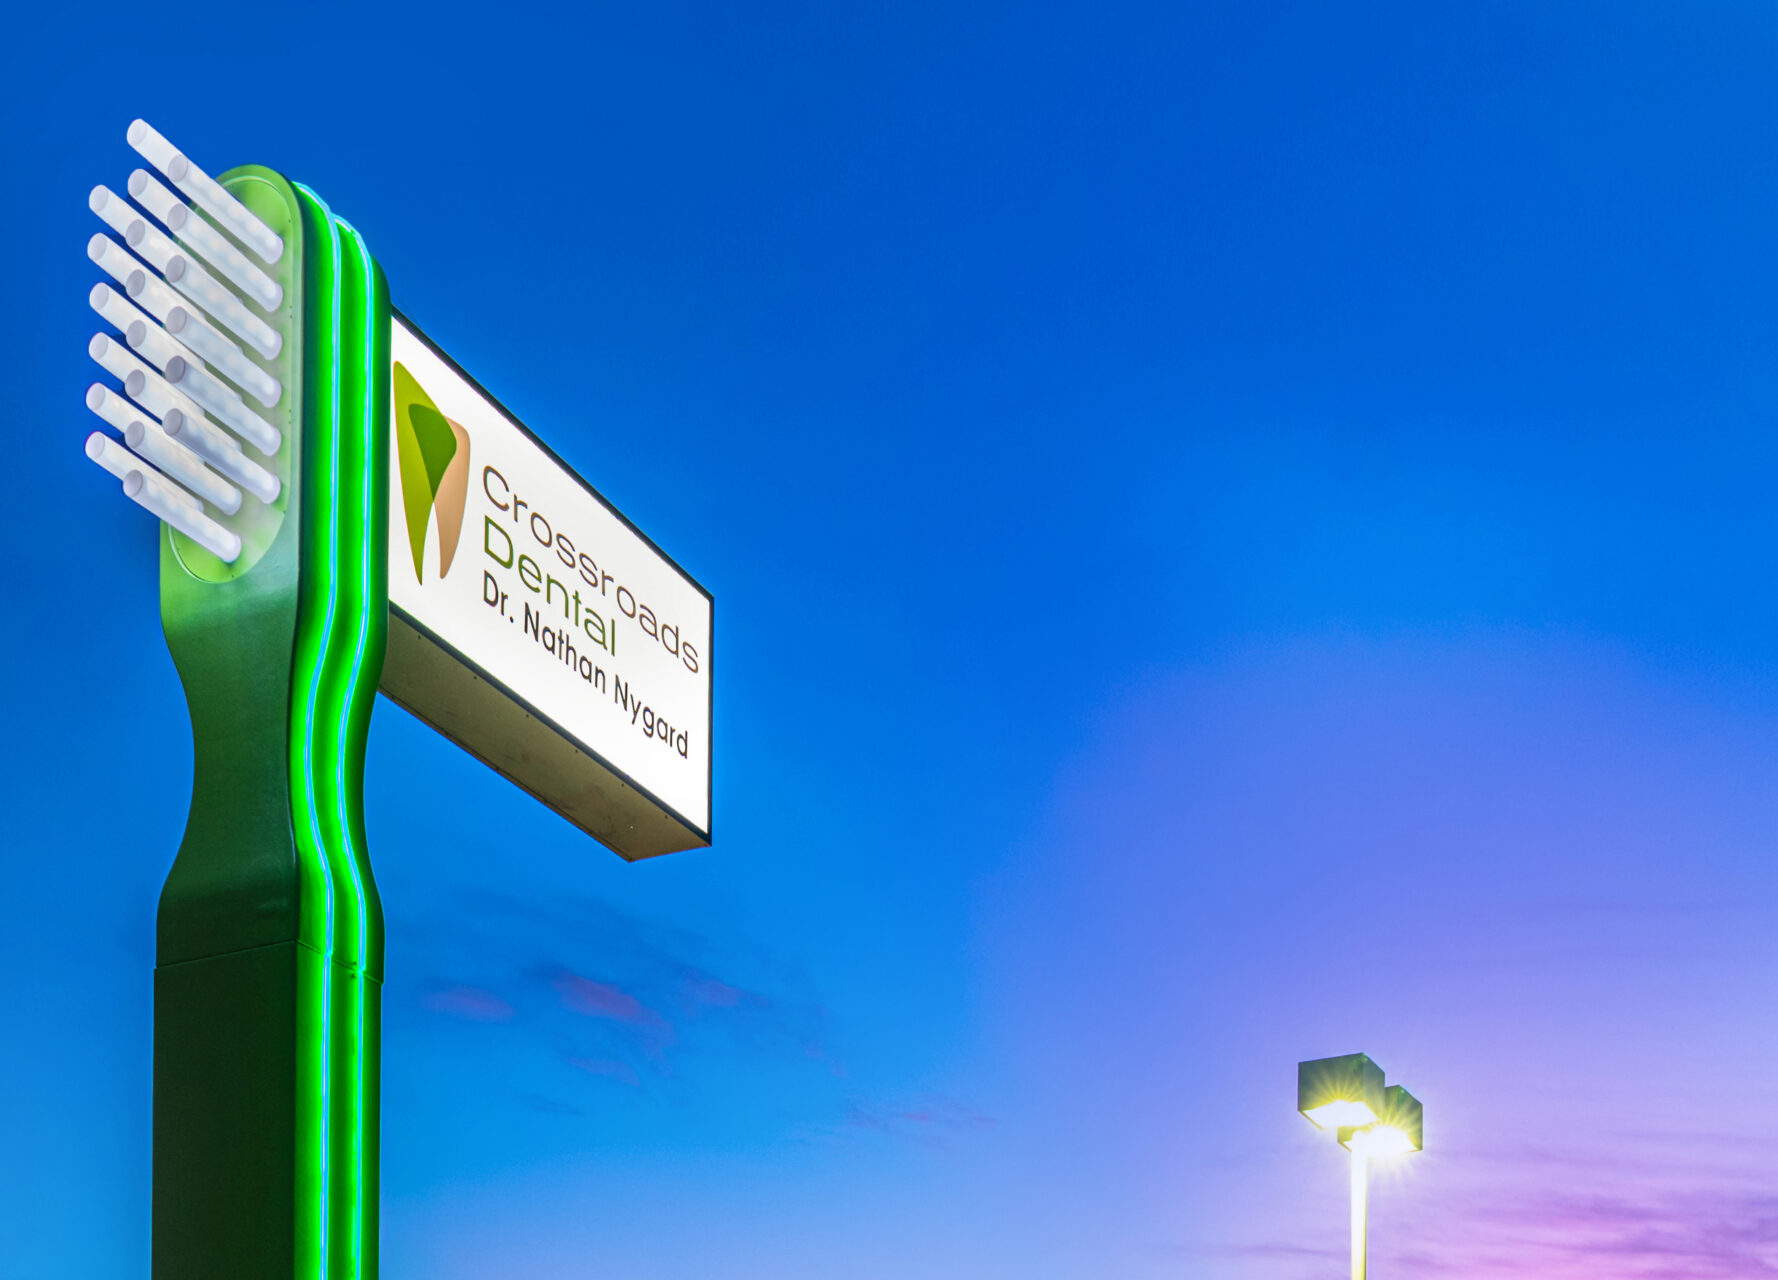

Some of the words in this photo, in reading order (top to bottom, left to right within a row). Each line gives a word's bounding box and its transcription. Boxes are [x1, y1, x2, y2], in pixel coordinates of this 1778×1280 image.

[483, 465, 700, 674] Crossroads
[484, 515, 616, 656] Dental
[483, 570, 514, 624] Dr.
[524, 602, 607, 694] Nathan
[615, 675, 689, 759] Nygard
